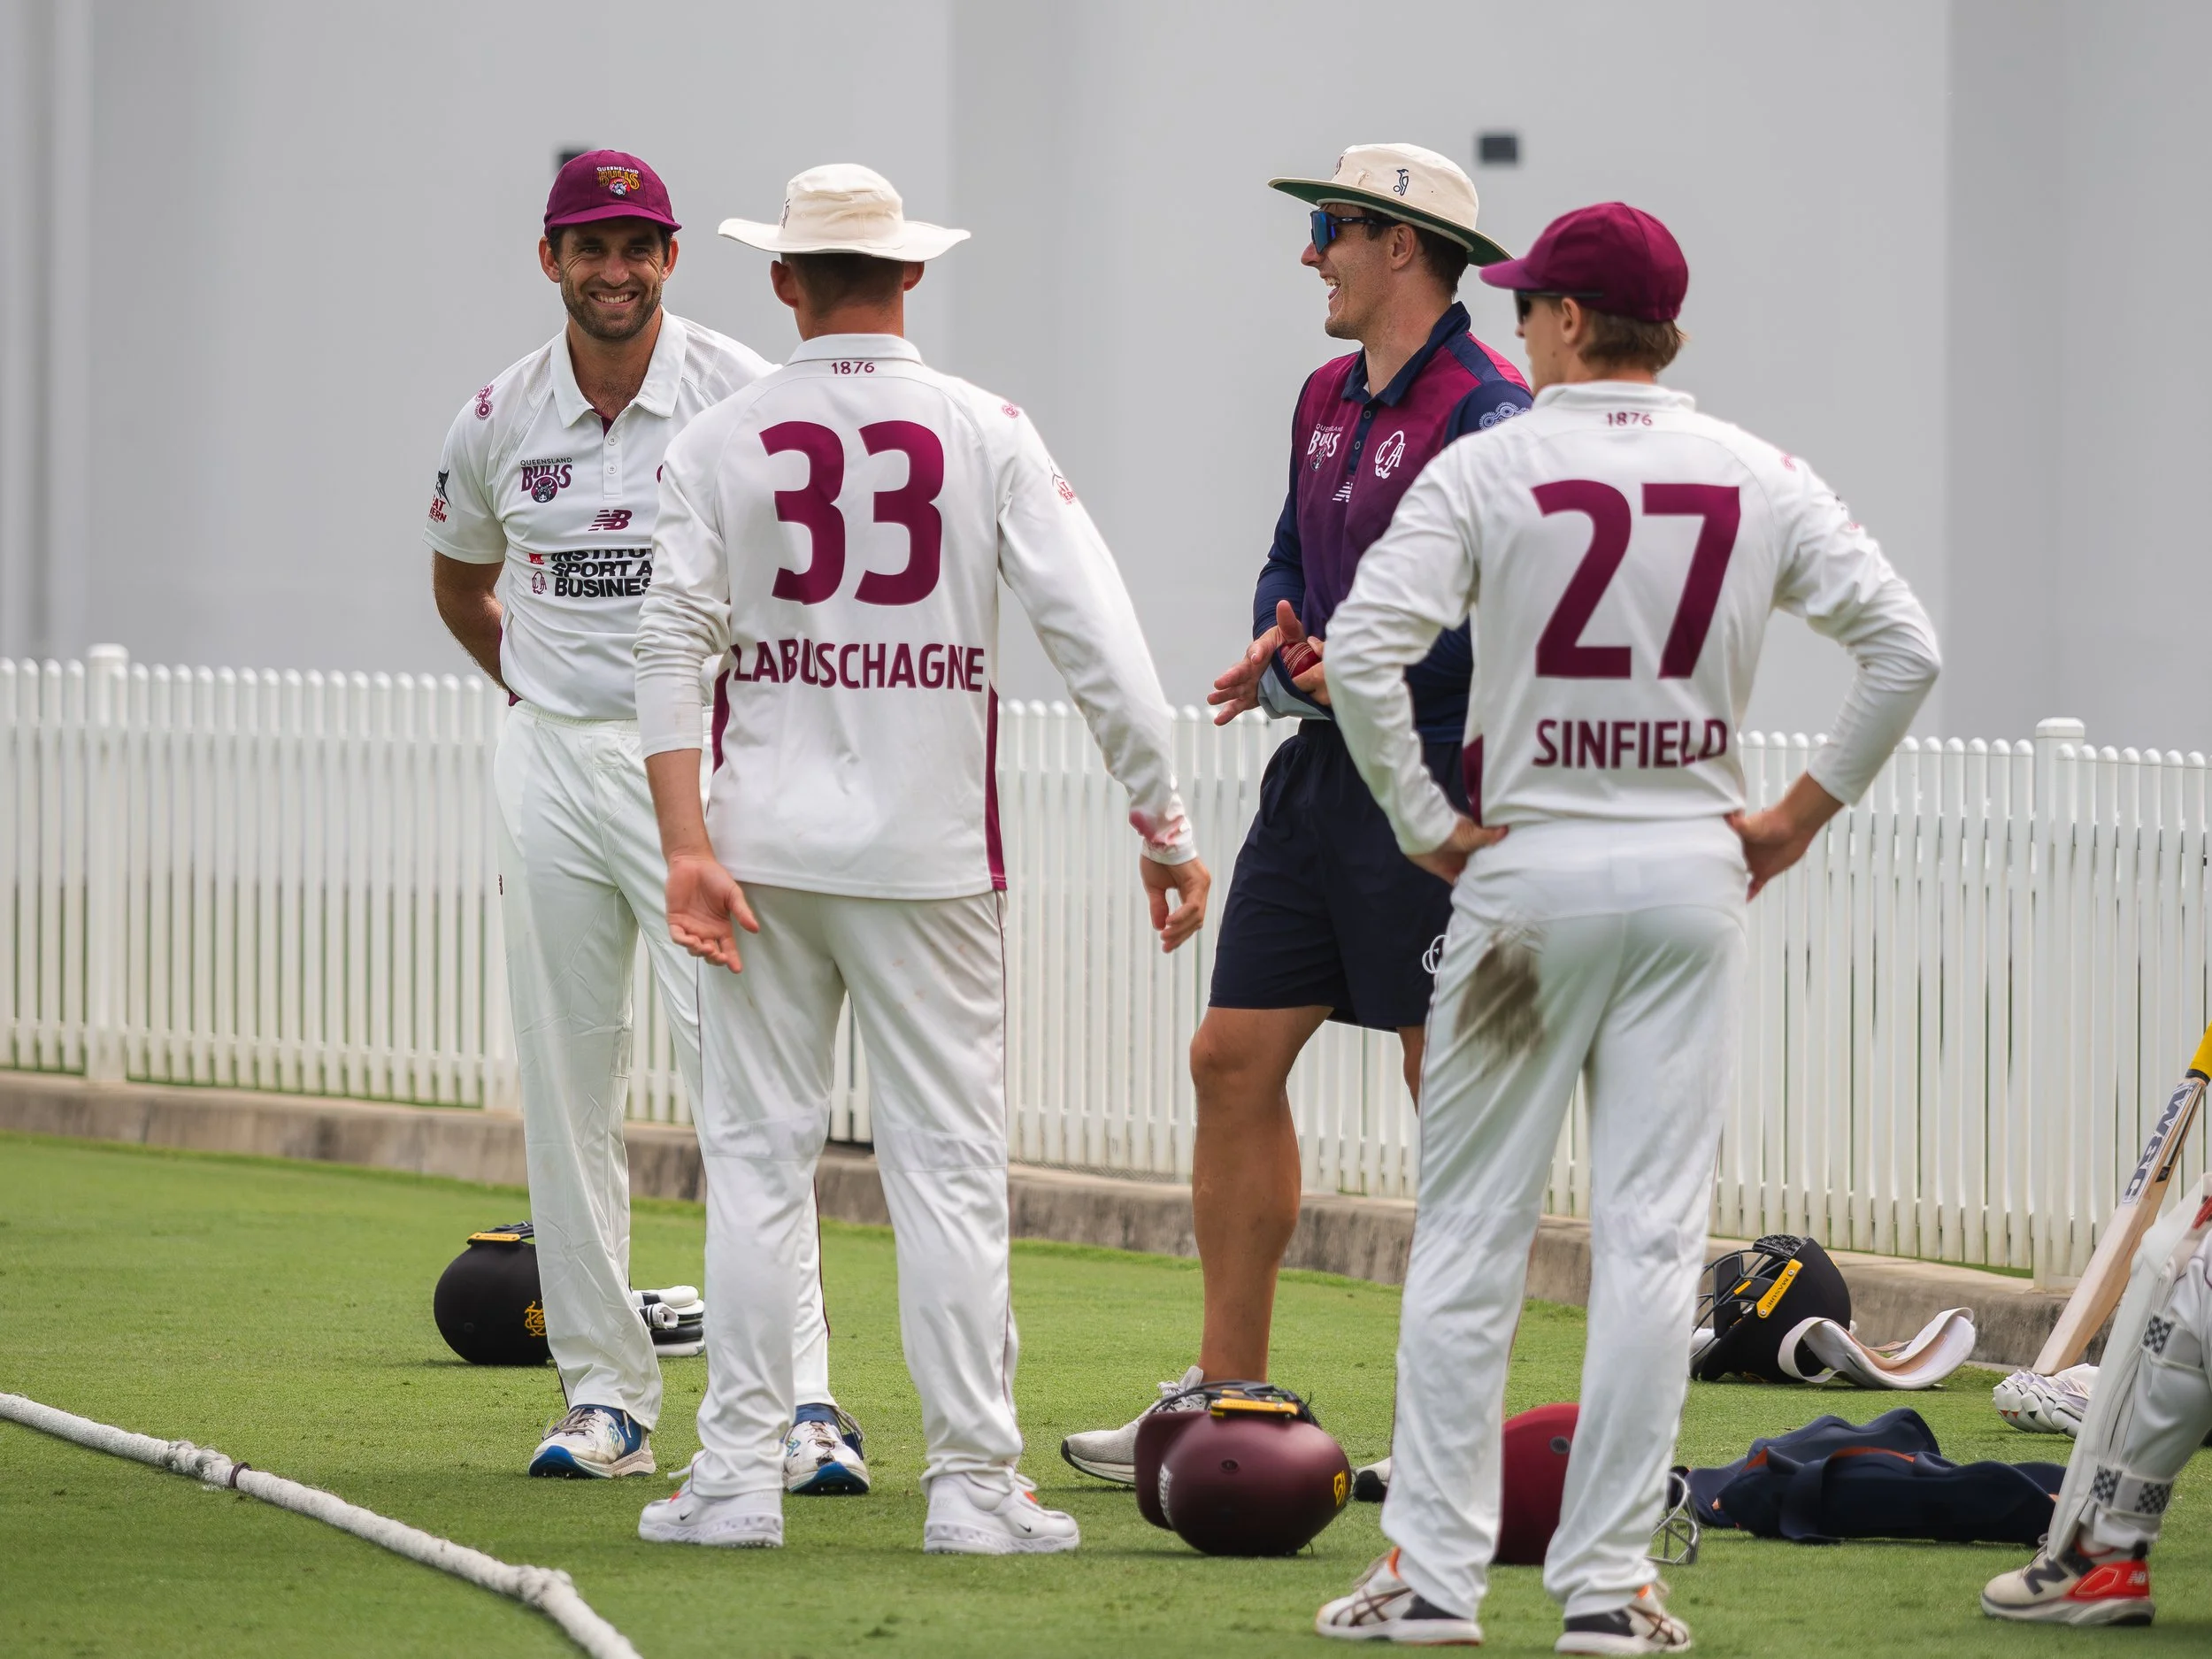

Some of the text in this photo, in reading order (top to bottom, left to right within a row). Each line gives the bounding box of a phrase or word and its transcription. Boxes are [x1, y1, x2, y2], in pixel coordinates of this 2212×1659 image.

[596, 165, 639, 174] QUEENSLAND
[598, 170, 640, 190] BULLS
[831, 361, 875, 375] 1876
[1606, 411, 1653, 427] 1876
[520, 457, 573, 467] QUEENSLAND
[520, 464, 573, 493] BULLS
[758, 419, 944, 606] 33
[549, 548, 654, 562] INSTITU
[550, 560, 633, 578] SPORT
[1531, 478, 1741, 680] 27
[730, 638, 984, 693] LABUSCHAGNE
[1532, 718, 1728, 769] SINFIELD
